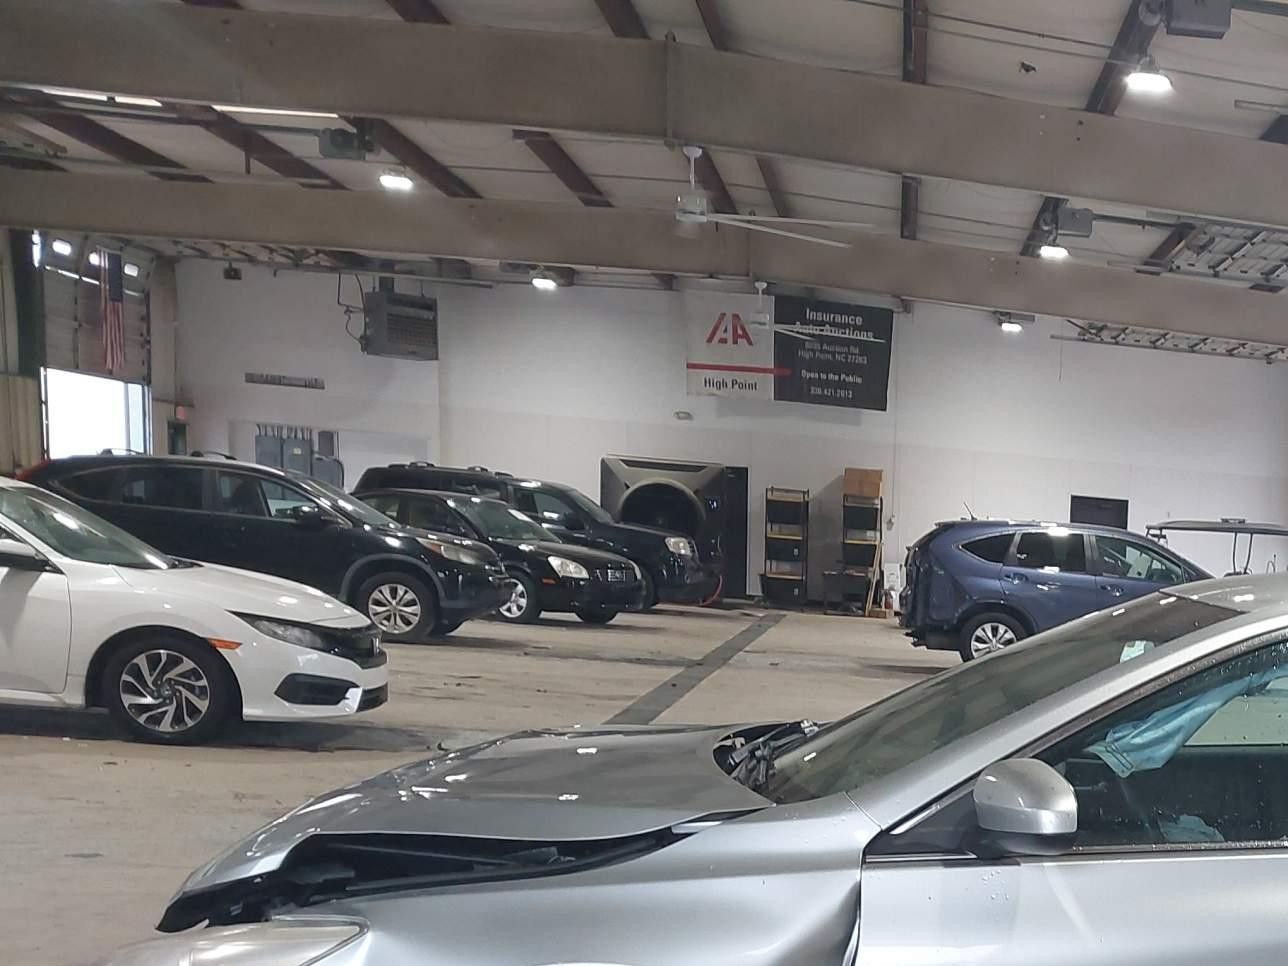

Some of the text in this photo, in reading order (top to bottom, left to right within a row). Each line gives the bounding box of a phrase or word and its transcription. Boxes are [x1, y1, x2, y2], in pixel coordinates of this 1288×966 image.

[806, 308, 863, 325] Insurance
[798, 348, 814, 360] High
[835, 353, 846, 362] NC
[801, 369, 863, 384] Open to the Public
[704, 377, 758, 391] High Point
